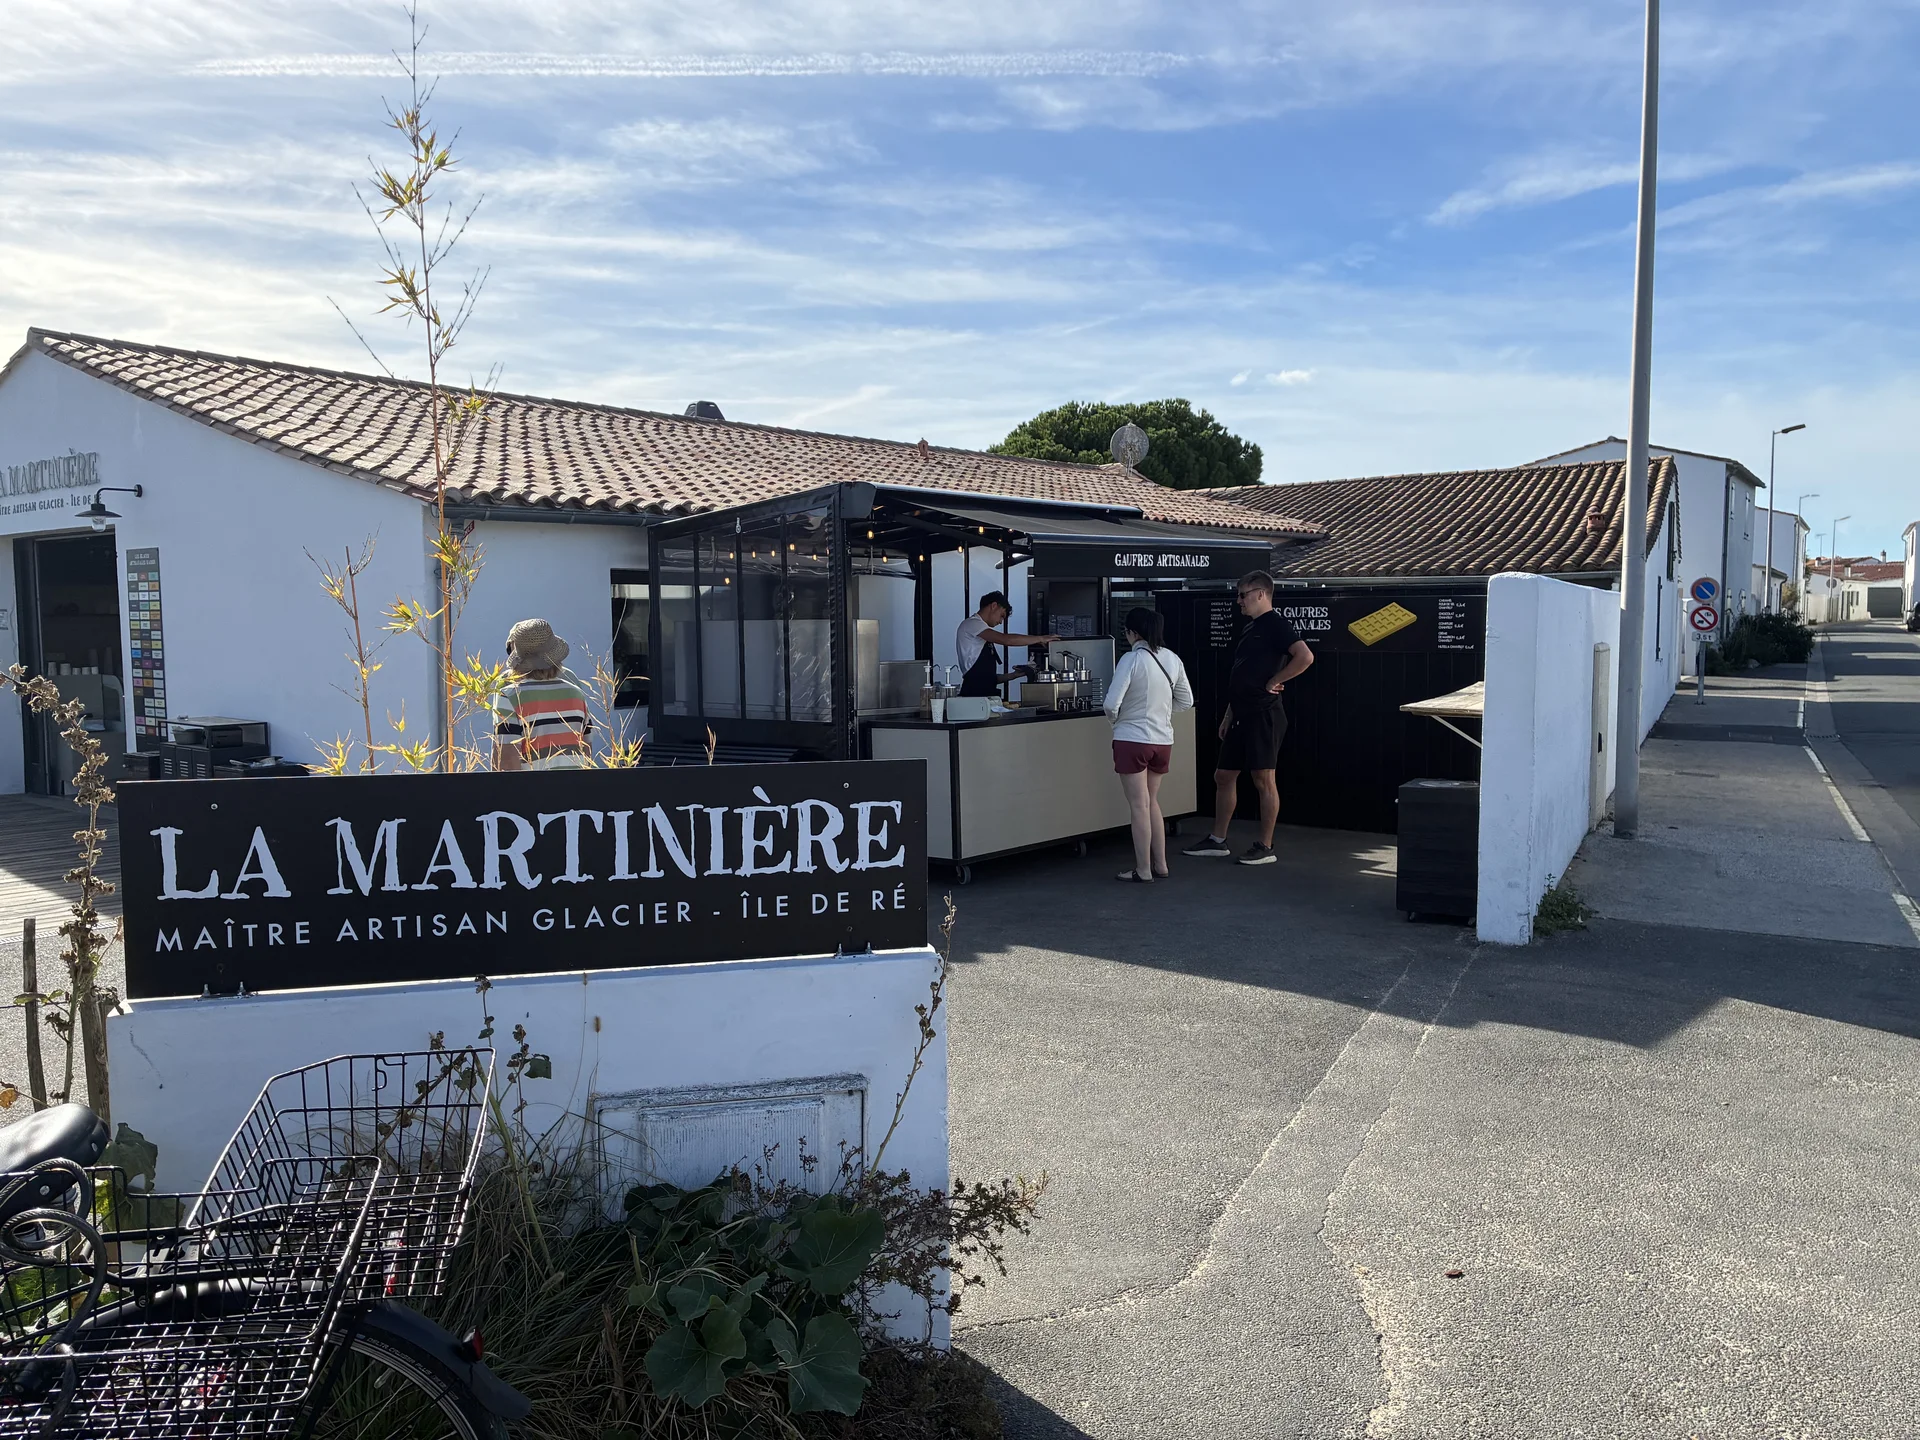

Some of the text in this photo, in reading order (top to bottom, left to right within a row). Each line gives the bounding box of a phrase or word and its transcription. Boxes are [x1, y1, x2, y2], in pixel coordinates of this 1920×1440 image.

[8, 447, 101, 497] MARTINIÈRE
[13, 501, 37, 514] ARTISAN
[38, 498, 64, 511] GLACIER
[82, 495, 92, 506] DE
[1114, 553, 1210, 568] GAUFRES ARTISANALES
[1283, 606, 1329, 618] GAUFRES
[149, 785, 905, 901] LA MARTINIÈRE
[155, 917, 311, 953] MAÎTRE
[335, 910, 508, 943] ARTISAN
[532, 901, 692, 931] GLACIER
[740, 891, 789, 919] ÎLE
[811, 891, 850, 915] DE
[871, 883, 906, 911] RÉ
